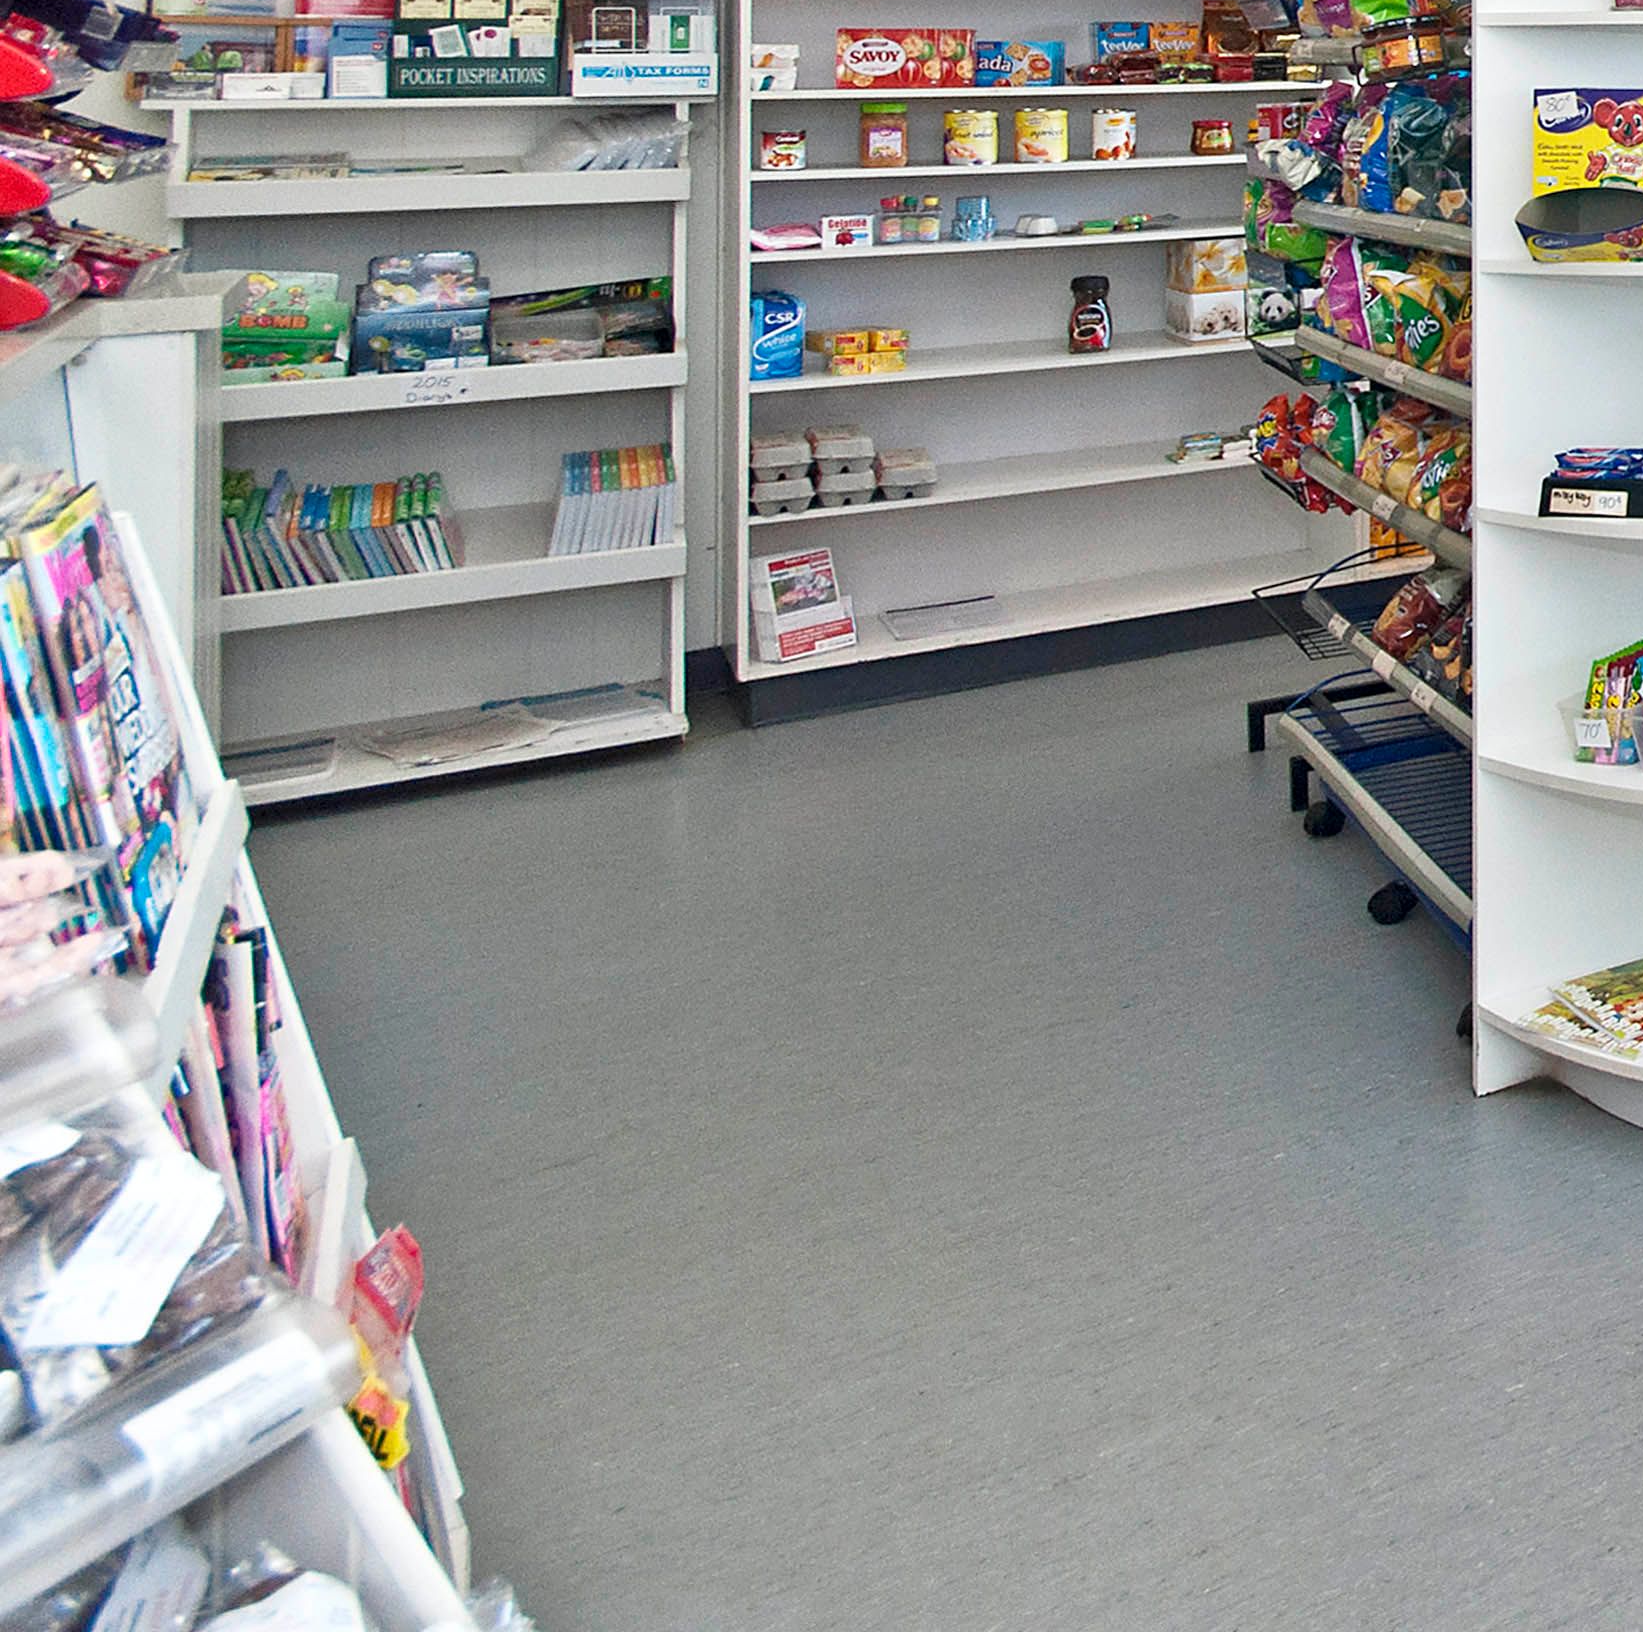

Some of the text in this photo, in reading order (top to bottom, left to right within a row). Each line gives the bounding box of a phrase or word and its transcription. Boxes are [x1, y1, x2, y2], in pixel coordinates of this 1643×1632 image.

[849, 49, 901, 66] SAVOY
[978, 57, 1013, 73] ada
[401, 66, 547, 86] POCKET INSPIRATIONS
[638, 65, 711, 76] TAX FORMS
[764, 312, 795, 326] CSR
[412, 374, 454, 389] 2015
